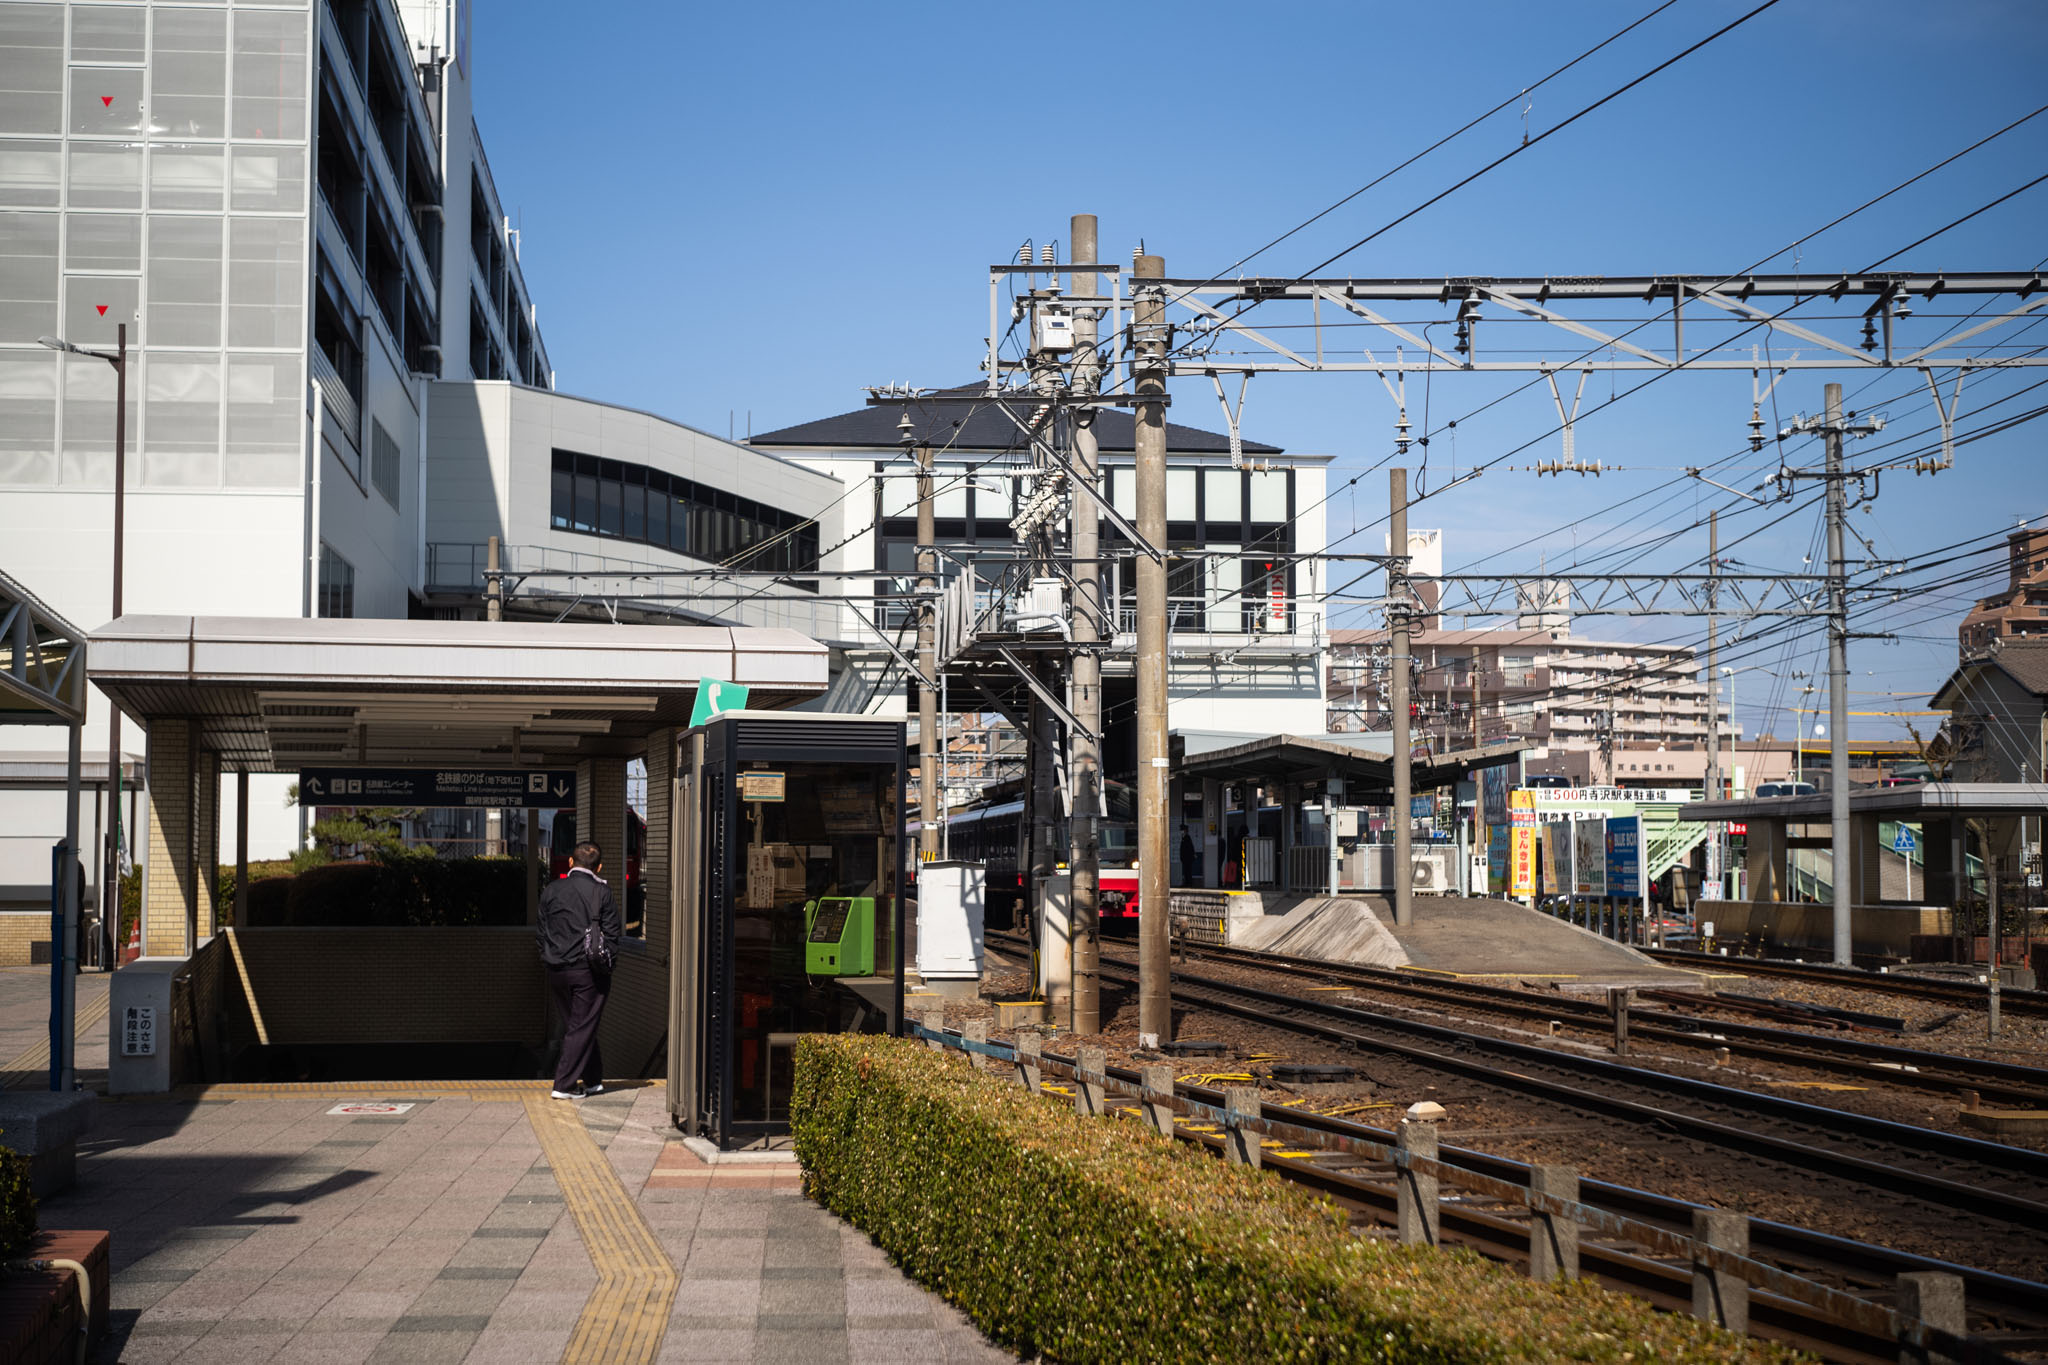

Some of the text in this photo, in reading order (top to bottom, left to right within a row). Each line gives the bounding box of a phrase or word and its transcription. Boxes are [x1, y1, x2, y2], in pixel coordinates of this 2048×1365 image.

[1233, 788, 1242, 801] 3
[127, 1007, 138, 1053] 階段注意
[140, 1008, 152, 1053] このさき
